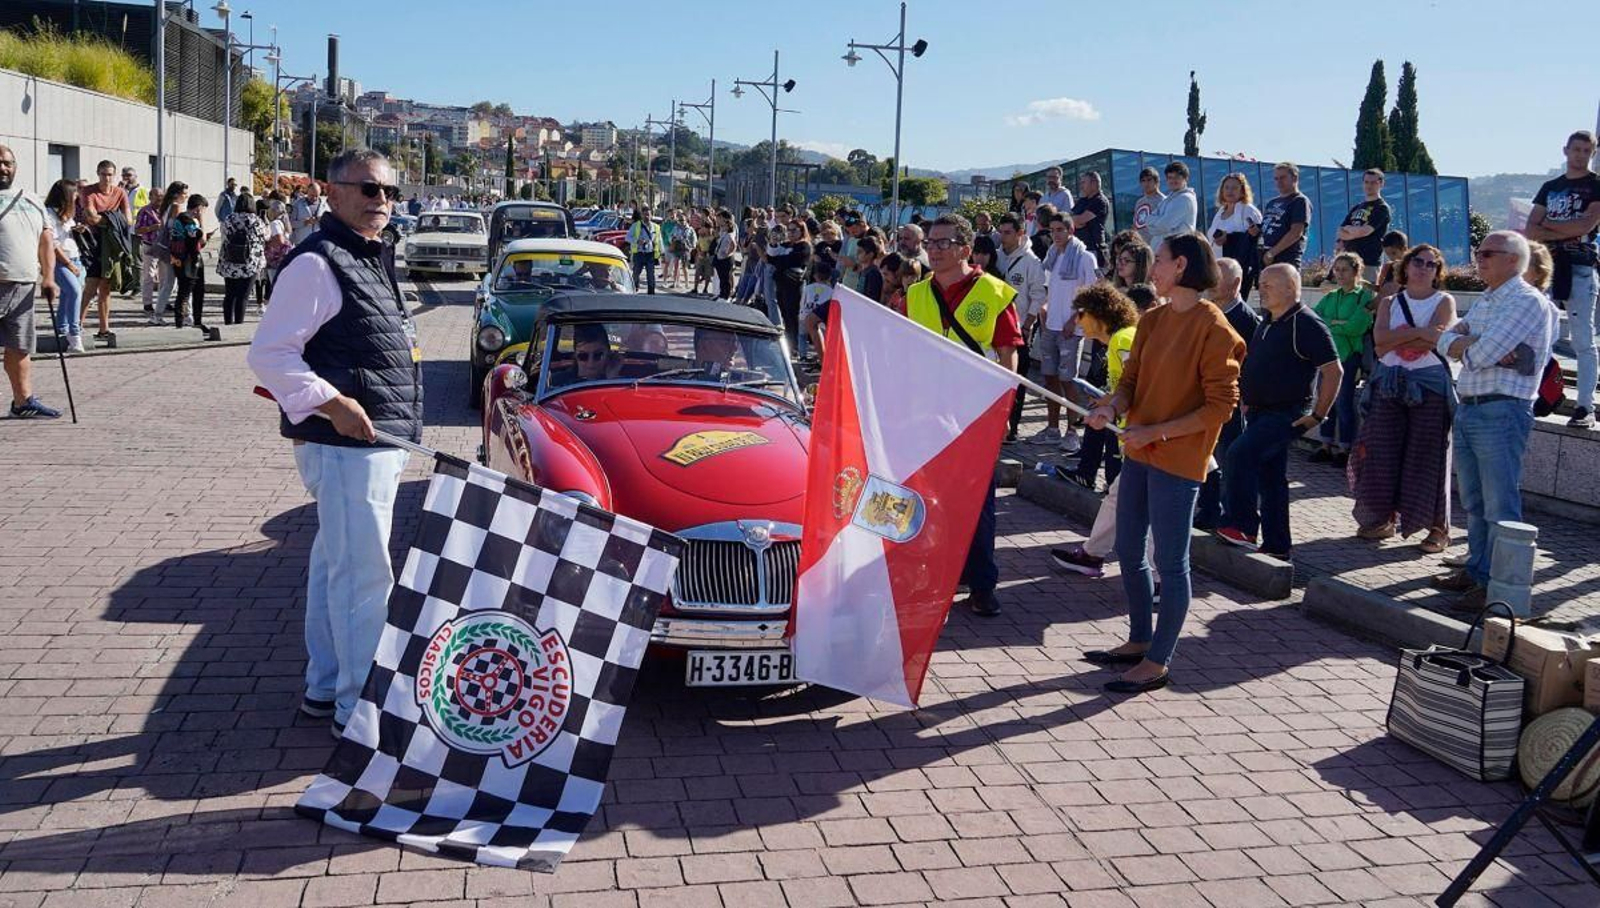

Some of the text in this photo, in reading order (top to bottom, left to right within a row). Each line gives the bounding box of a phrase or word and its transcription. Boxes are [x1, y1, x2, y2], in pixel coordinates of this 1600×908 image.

[419, 626, 452, 700] CLASICOS
[506, 634, 569, 760] ESCUDERIA
[517, 666, 550, 728] VIGO
[690, 653, 797, 682] H-3346-B
